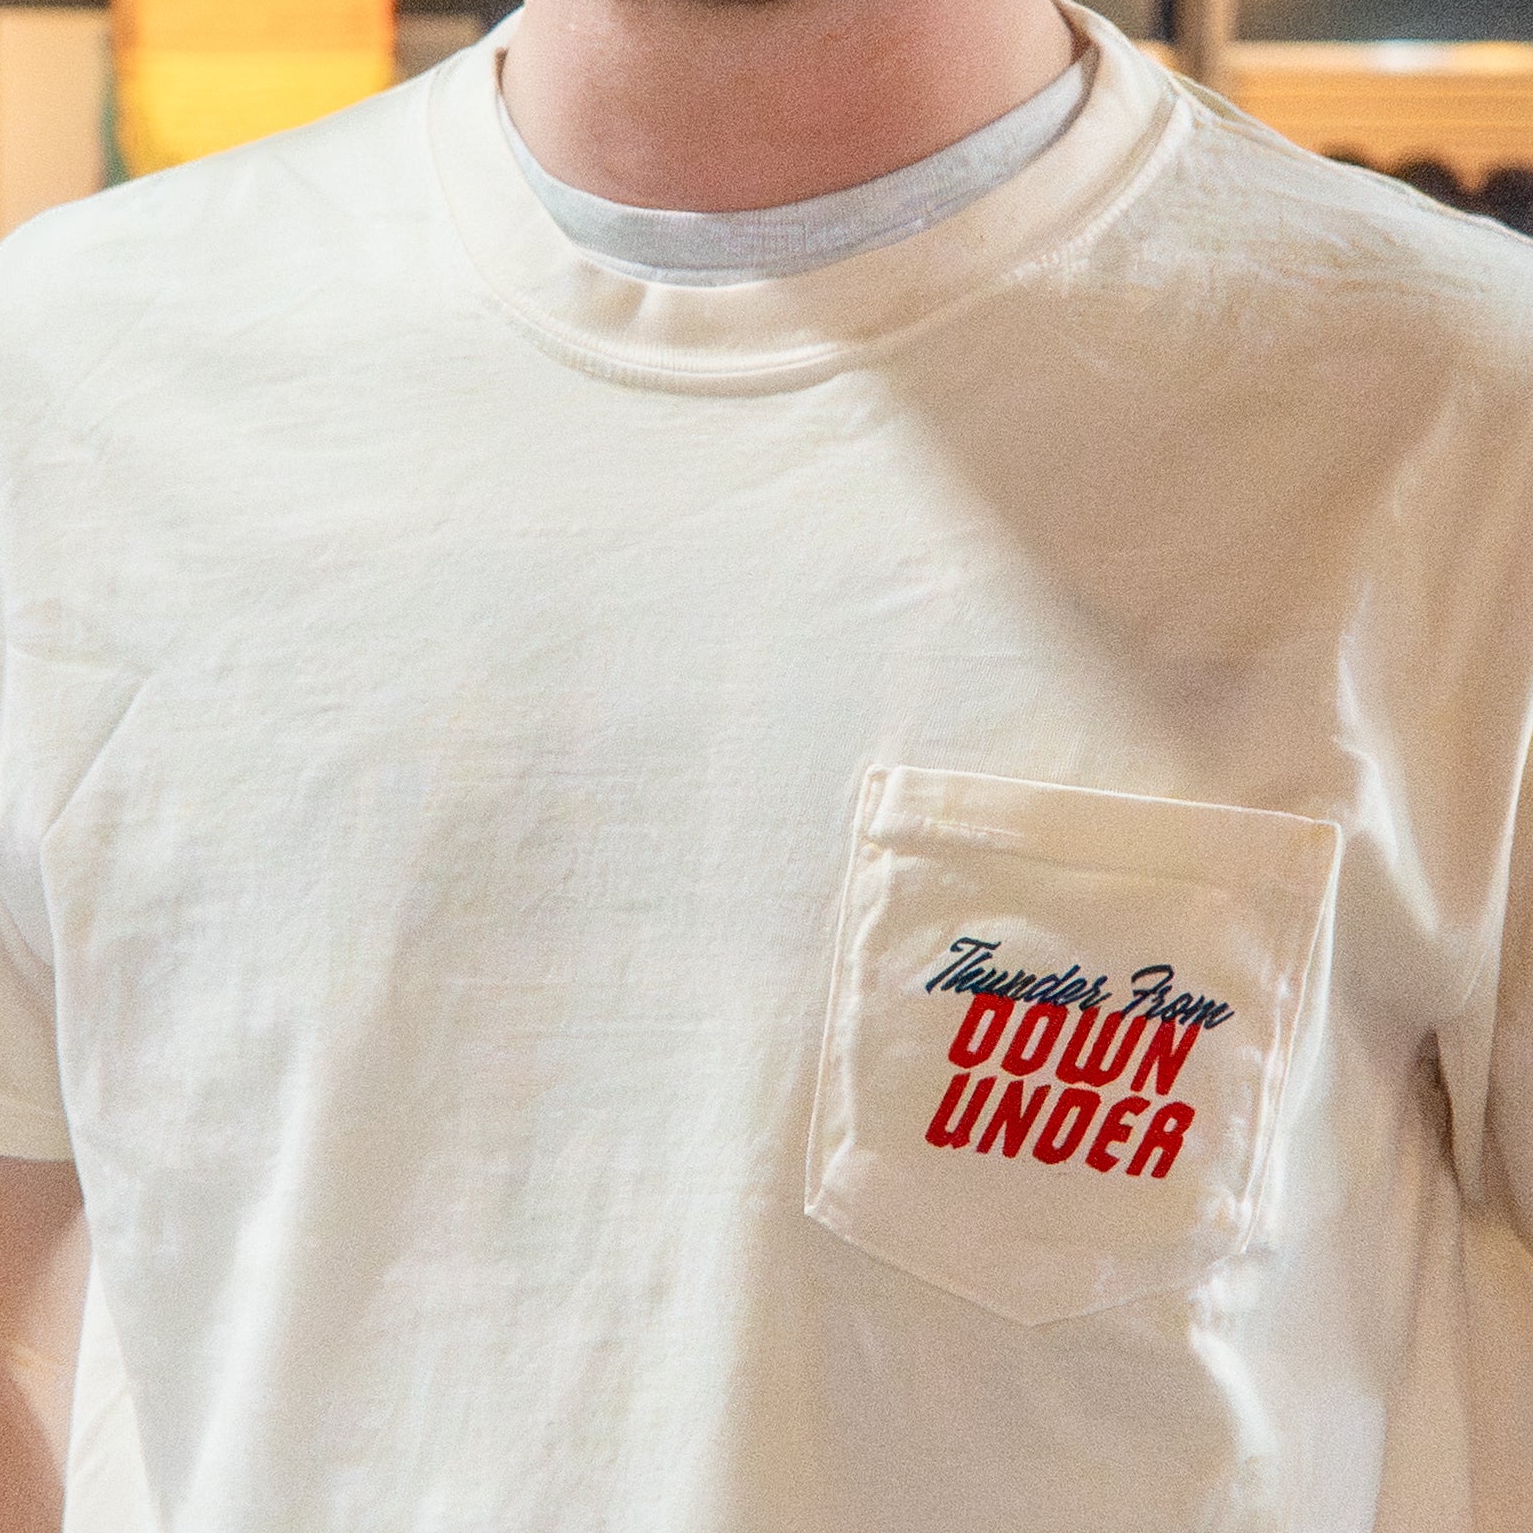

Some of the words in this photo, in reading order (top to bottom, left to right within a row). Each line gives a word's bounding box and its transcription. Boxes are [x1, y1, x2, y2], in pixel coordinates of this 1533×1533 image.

[925, 936, 1112, 1013] Thunder
[1120, 964, 1235, 1030] From
[947, 992, 1202, 1096] DOWN
[924, 1072, 1196, 1179] UNDER
